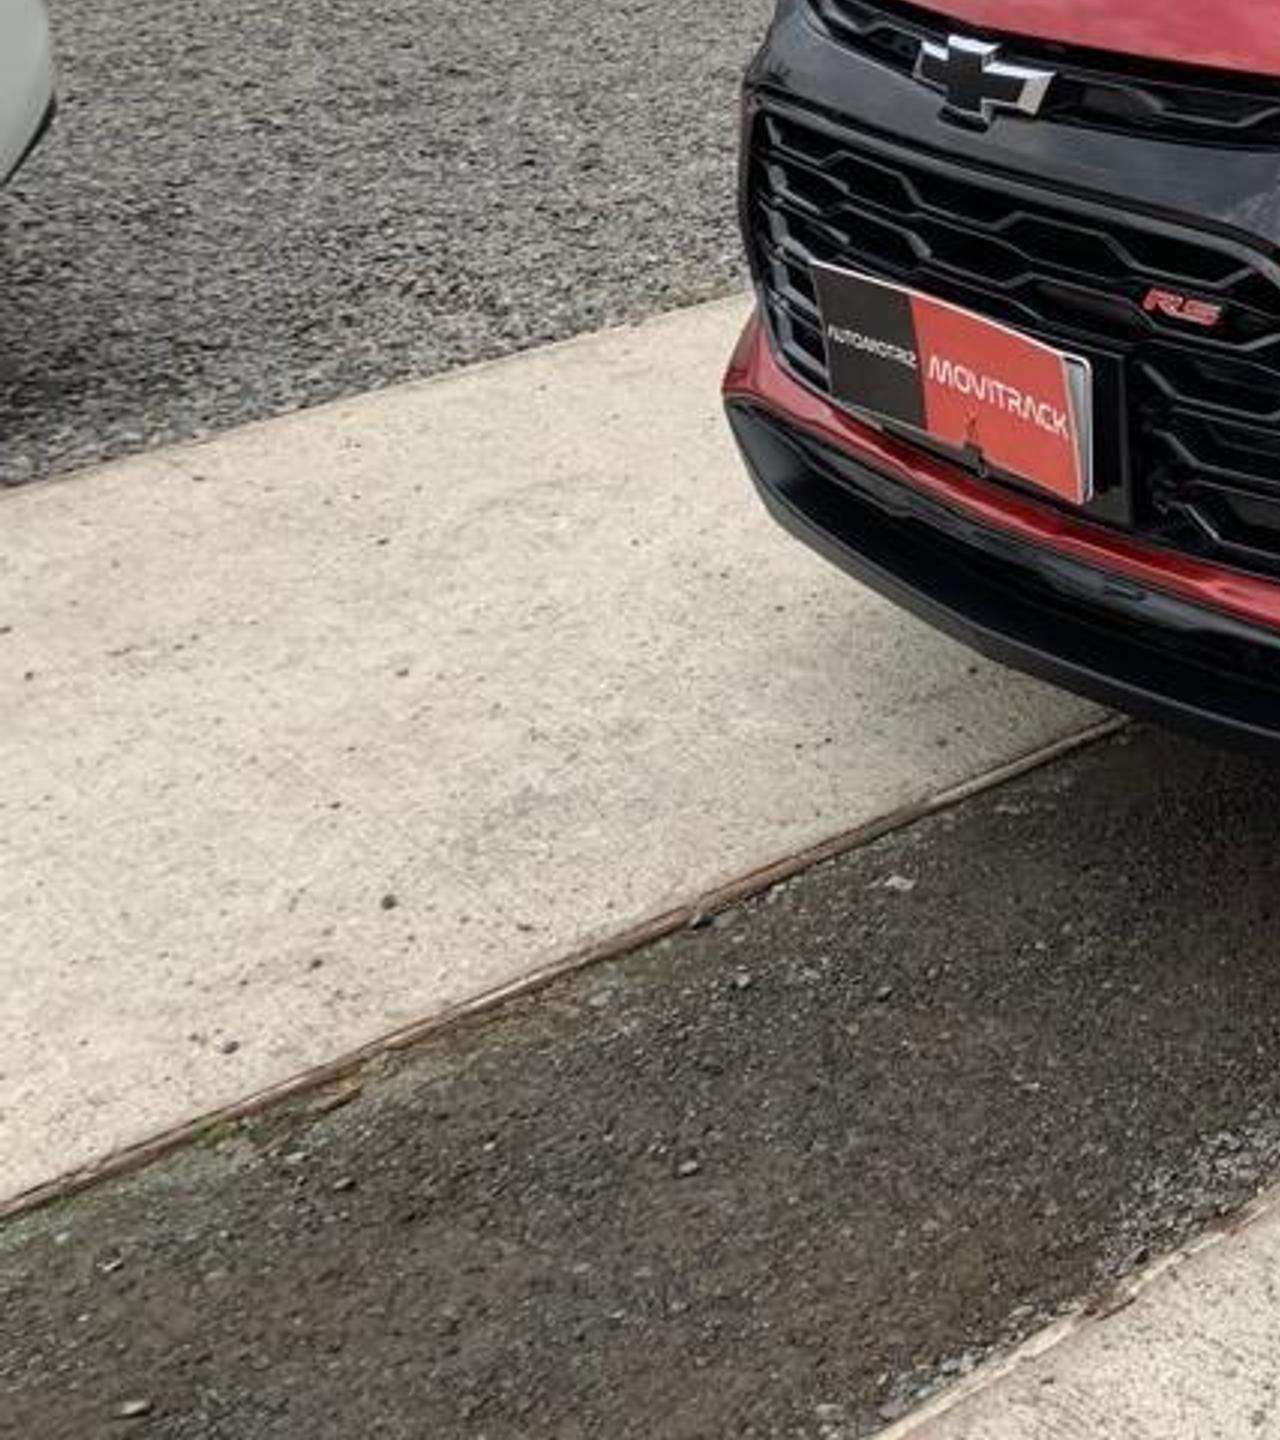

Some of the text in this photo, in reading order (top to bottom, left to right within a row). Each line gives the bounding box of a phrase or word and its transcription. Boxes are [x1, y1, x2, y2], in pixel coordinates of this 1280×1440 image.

[1143, 288, 1222, 326] RS
[827, 323, 1070, 439] AUTOMOTRIZ MOVITRACK
